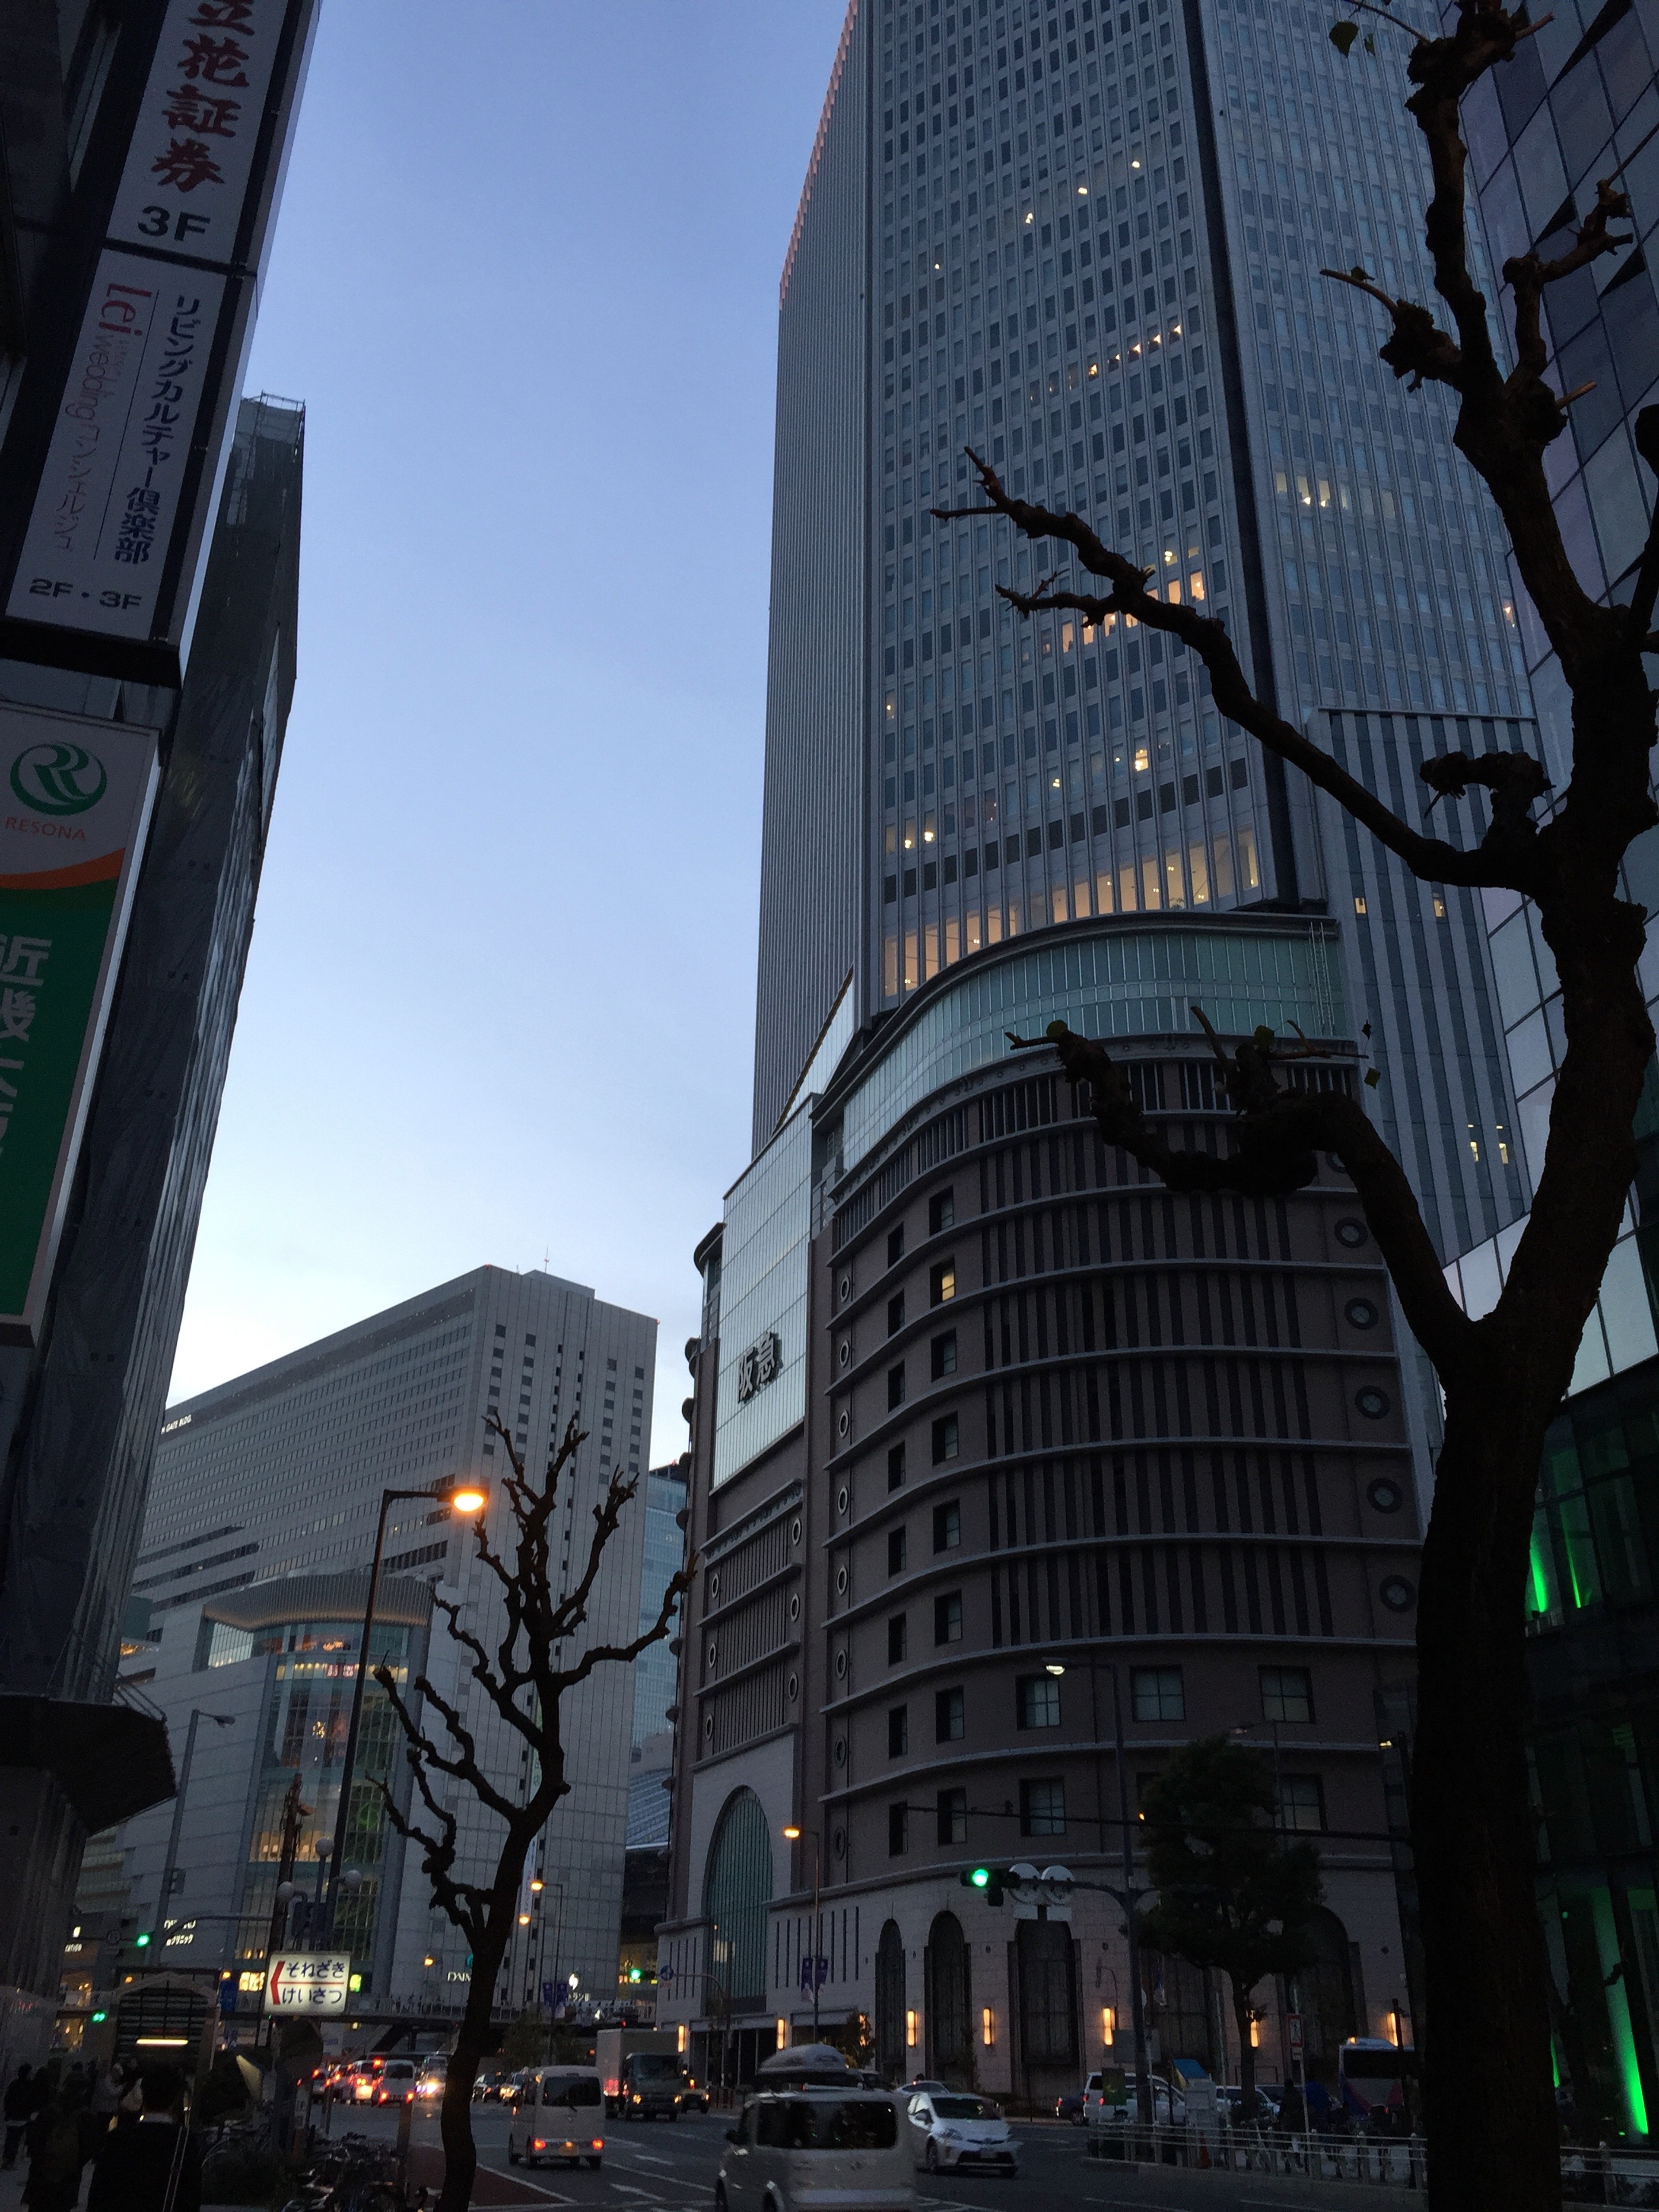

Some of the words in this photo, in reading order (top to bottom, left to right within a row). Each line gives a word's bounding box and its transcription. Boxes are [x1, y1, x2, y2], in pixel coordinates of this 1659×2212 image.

[151, 0, 255, 193] 立花証券
[138, 206, 211, 242] 3F
[99, 283, 153, 336] Lei
[114, 295, 201, 565] リビングカルチャー倶楽部
[4, 817, 86, 841] RESONA
[739, 1332, 775, 1400] 阪急
[286, 1960, 344, 1978] そねざき
[282, 1988, 343, 2005] けいさつ
